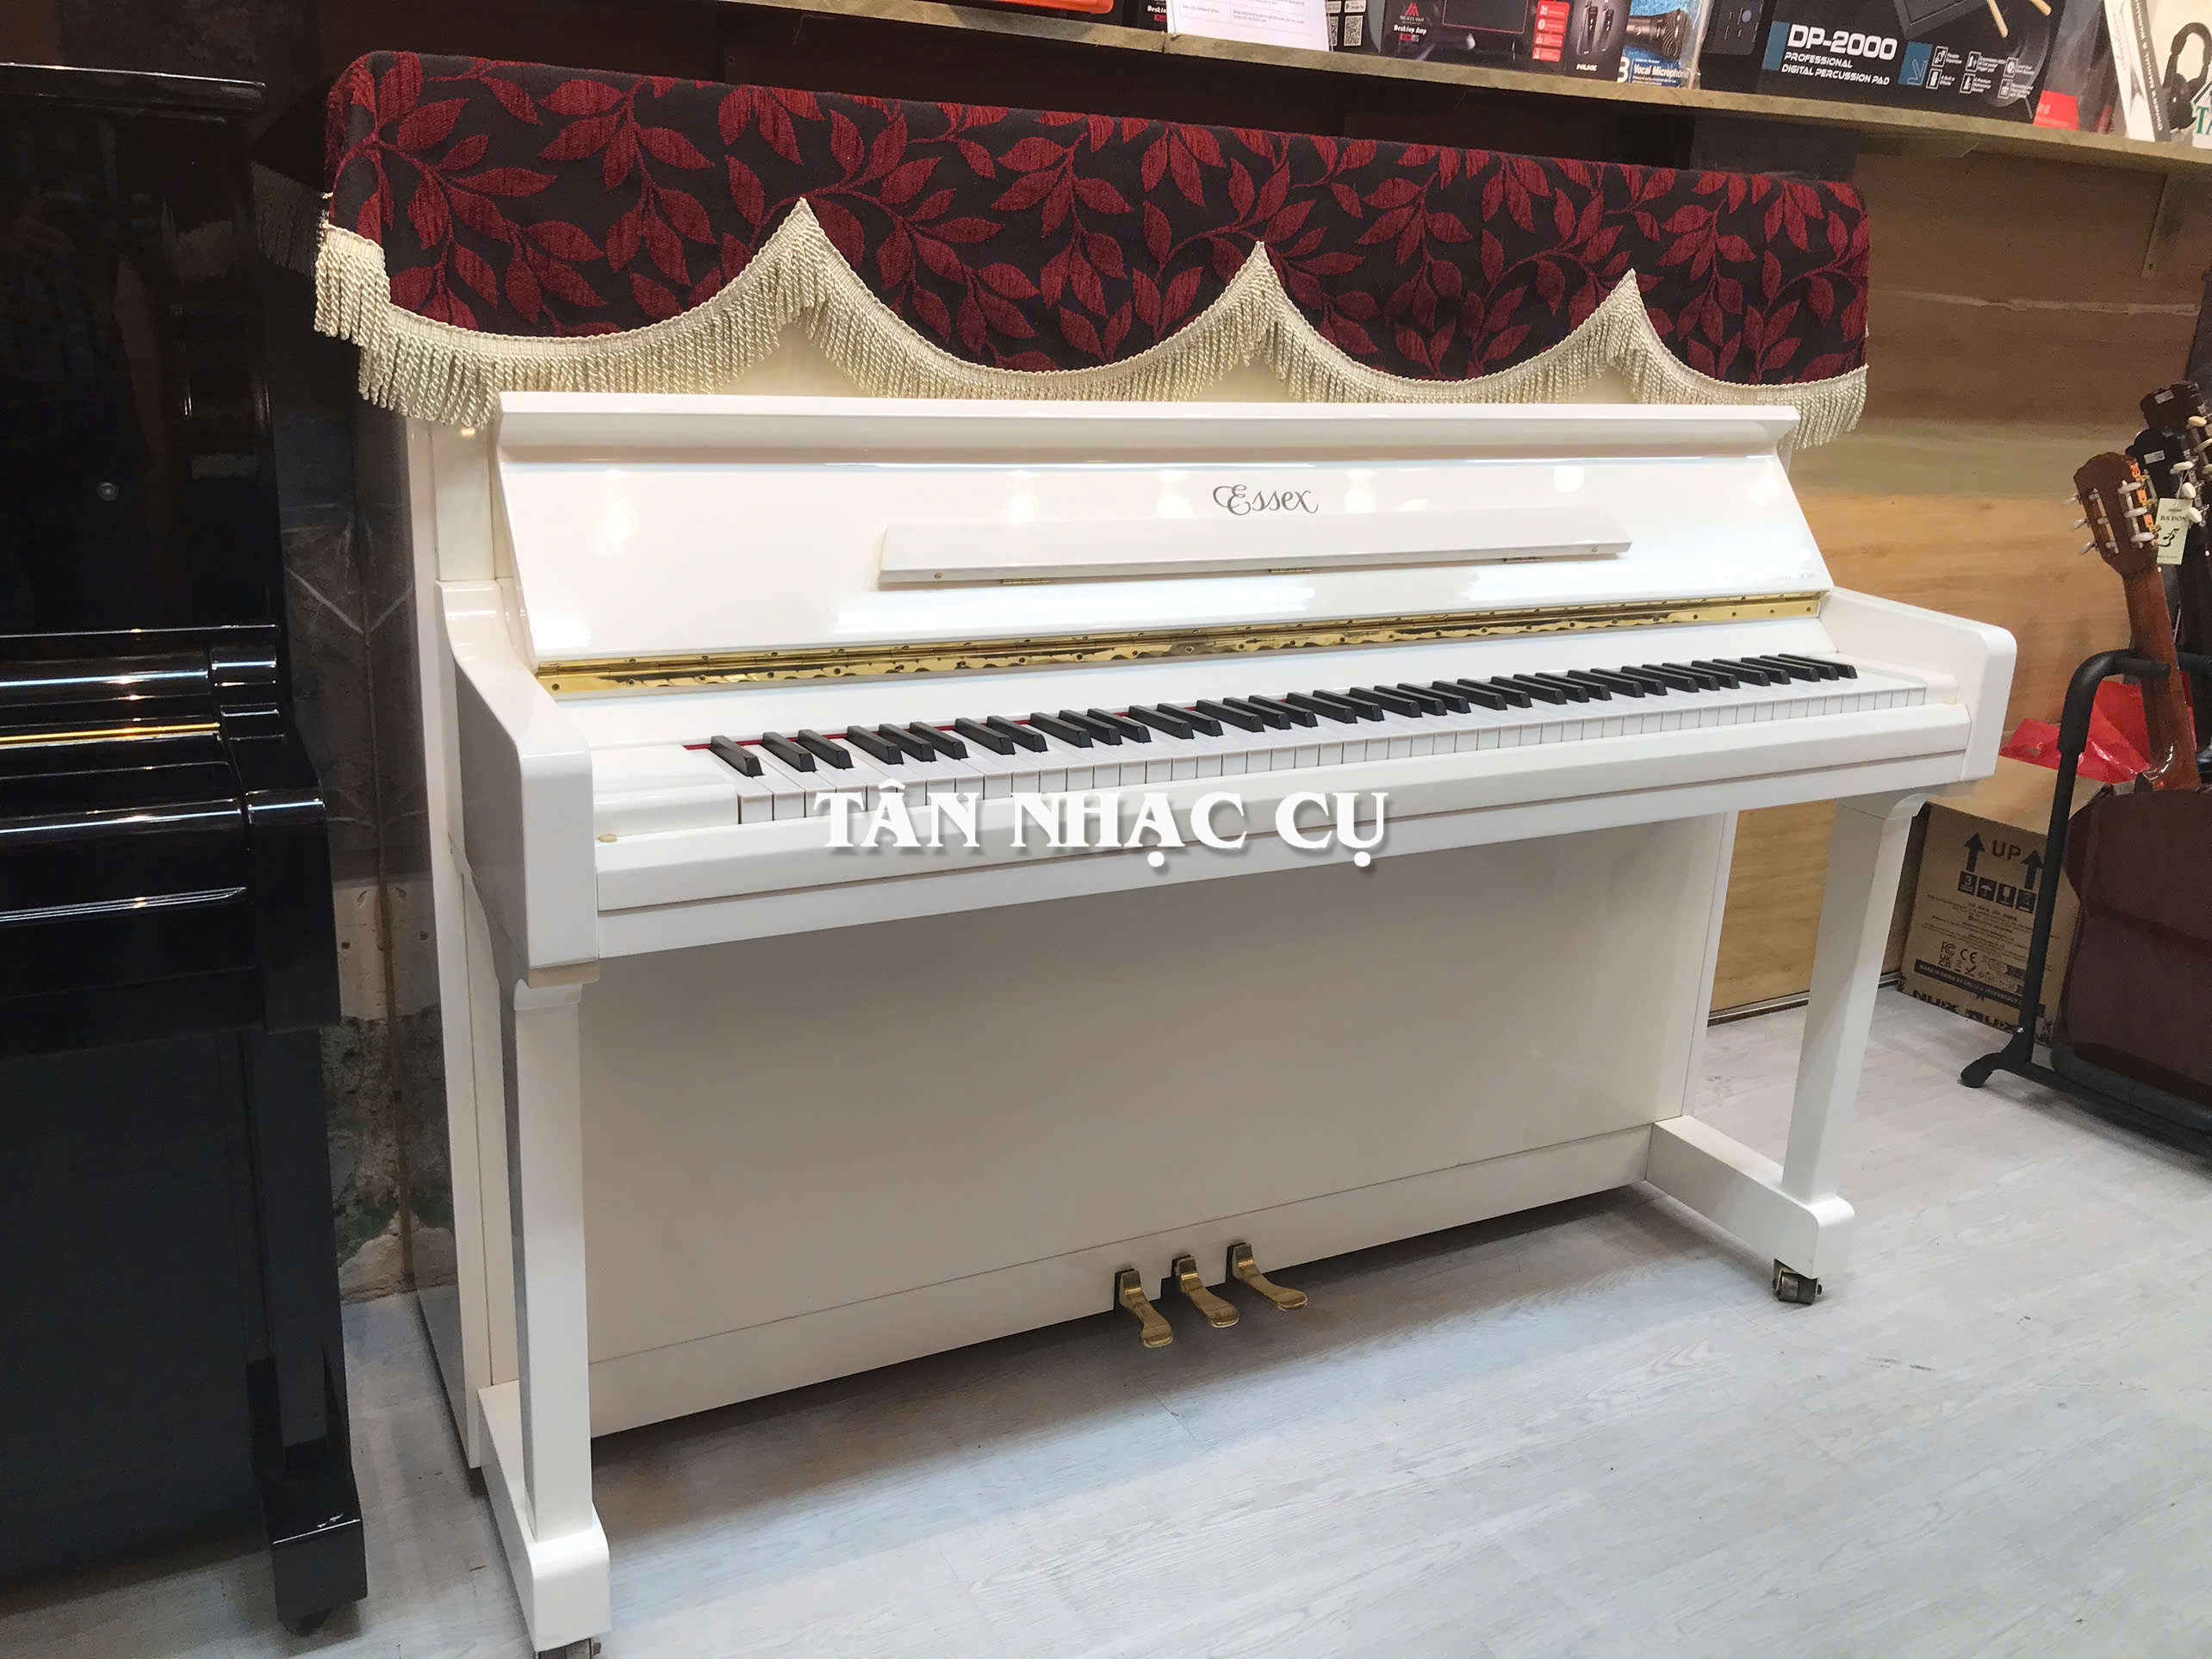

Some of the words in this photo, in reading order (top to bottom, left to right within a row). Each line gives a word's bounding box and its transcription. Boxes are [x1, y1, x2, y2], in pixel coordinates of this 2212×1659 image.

[1147, 5, 1166, 14] Deskto
[1394, 24, 1415, 34] Desktop
[1415, 27, 1427, 35] Amp
[1787, 23, 1898, 61] DP-2000
[1575, 63, 1598, 71] NUX
[1784, 51, 1854, 69] PROFESSIONAL
[1634, 64, 1651, 75] Vocal
[1652, 65, 1689, 79] Microphone
[1781, 64, 1815, 77] DIGITAL
[1815, 67, 1872, 84] PERCUSSION
[1872, 75, 1891, 86] PAD
[2196, 106, 2212, 135] T
[1212, 484, 1319, 516] Essex
[1991, 840, 2022, 861] UP
[1960, 948, 1978, 965] CE
[1913, 989, 1959, 1014] NUX
